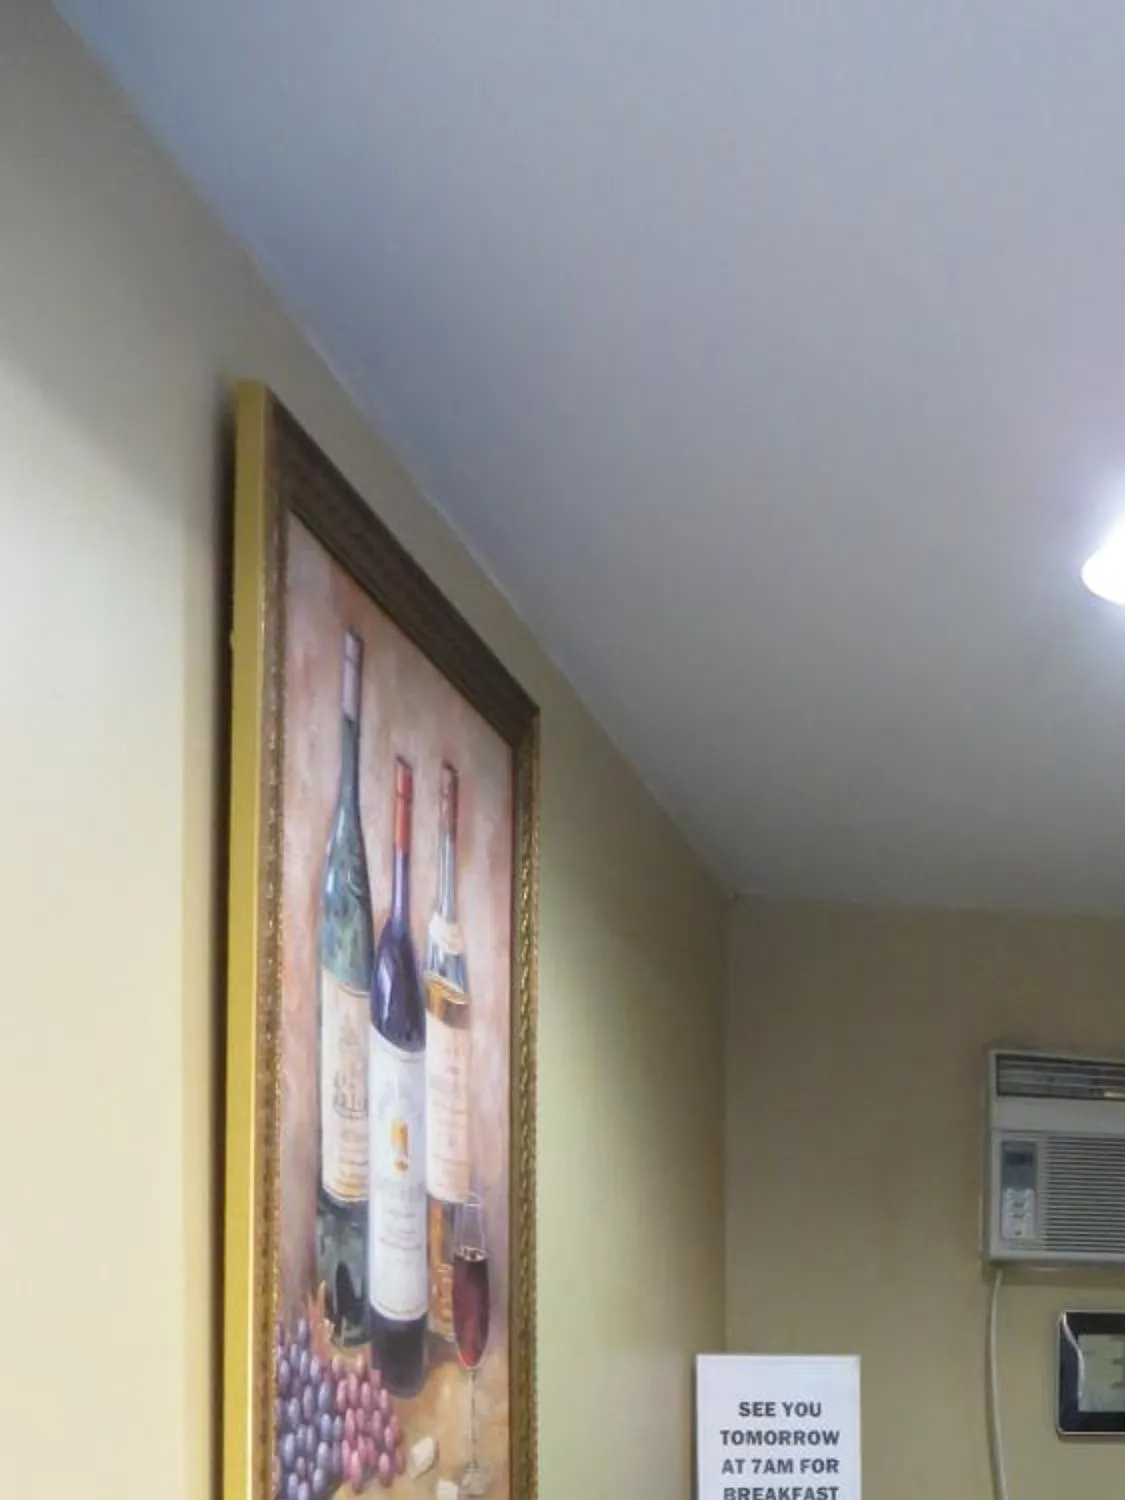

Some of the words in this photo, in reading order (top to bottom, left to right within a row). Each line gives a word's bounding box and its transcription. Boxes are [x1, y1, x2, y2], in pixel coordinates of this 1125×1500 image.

[738, 1401, 776, 1417] SEE
[782, 1401, 822, 1417] YOU
[720, 1430, 840, 1446] TOMORROW
[721, 1459, 745, 1474] AT
[751, 1459, 794, 1474] 7AM
[800, 1459, 839, 1474] FOR
